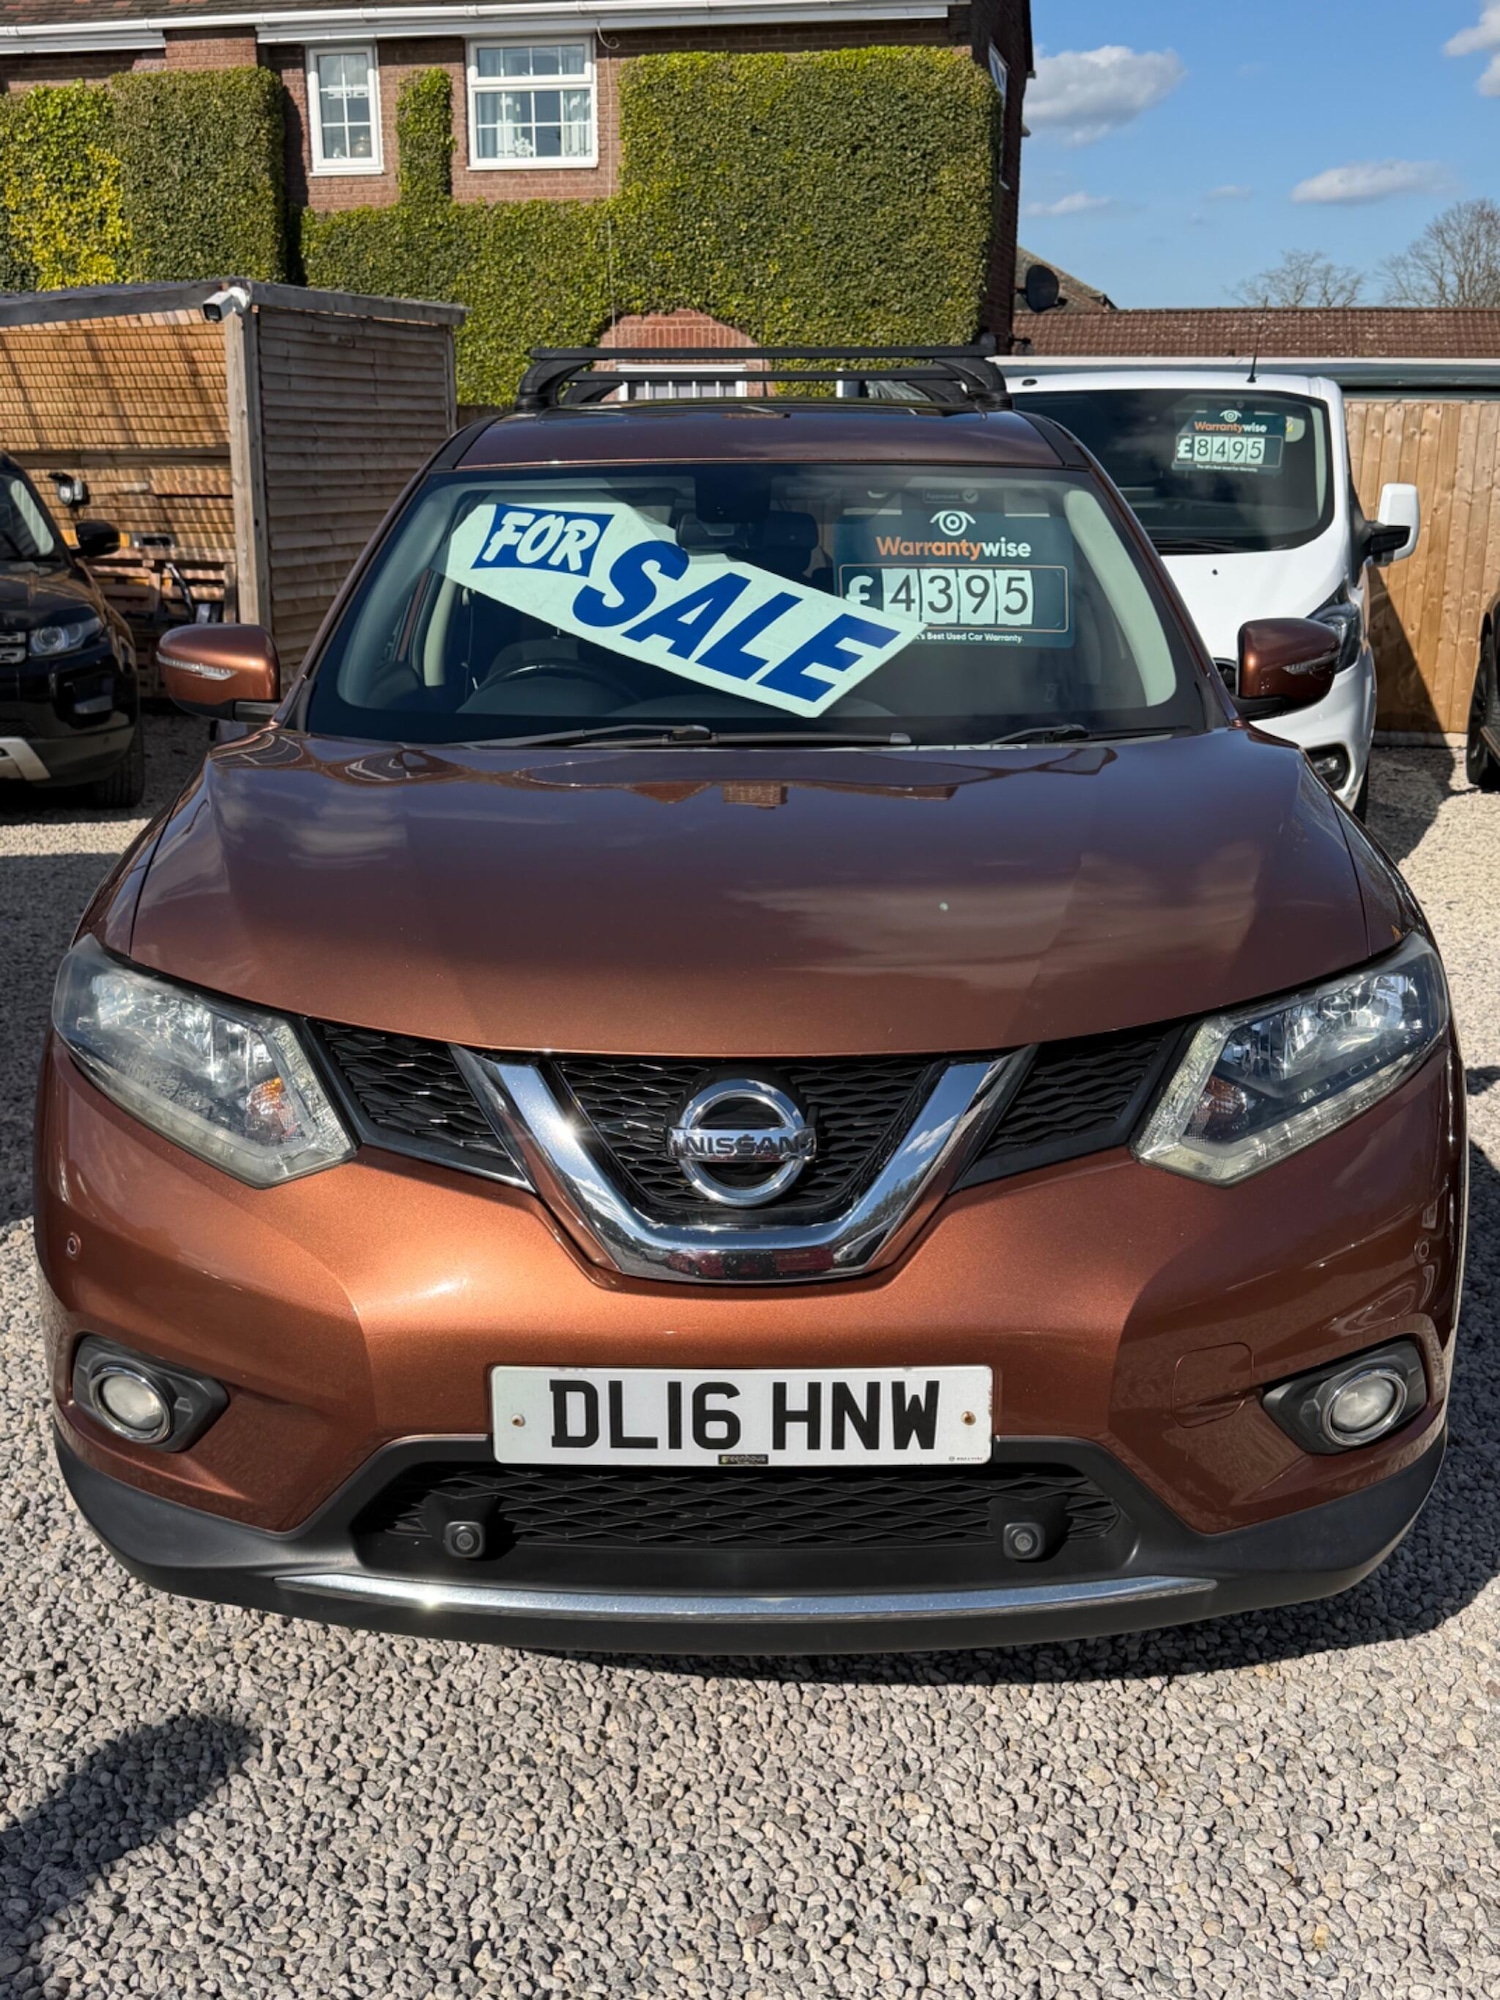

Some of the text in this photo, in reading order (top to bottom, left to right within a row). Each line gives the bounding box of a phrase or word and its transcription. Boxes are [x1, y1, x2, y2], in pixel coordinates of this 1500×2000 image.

[1194, 421, 1267, 433] Warrantywise
[875, 536, 1032, 560] Warrantywise
[483, 511, 902, 703] FOR SALE
[927, 632, 945, 640] Best
[946, 632, 966, 641] Used
[968, 632, 983, 641] Car
[984, 633, 1024, 644] Warranty.
[684, 1135, 800, 1155] NISSAN
[549, 1379, 941, 1450] DL16 HNW
